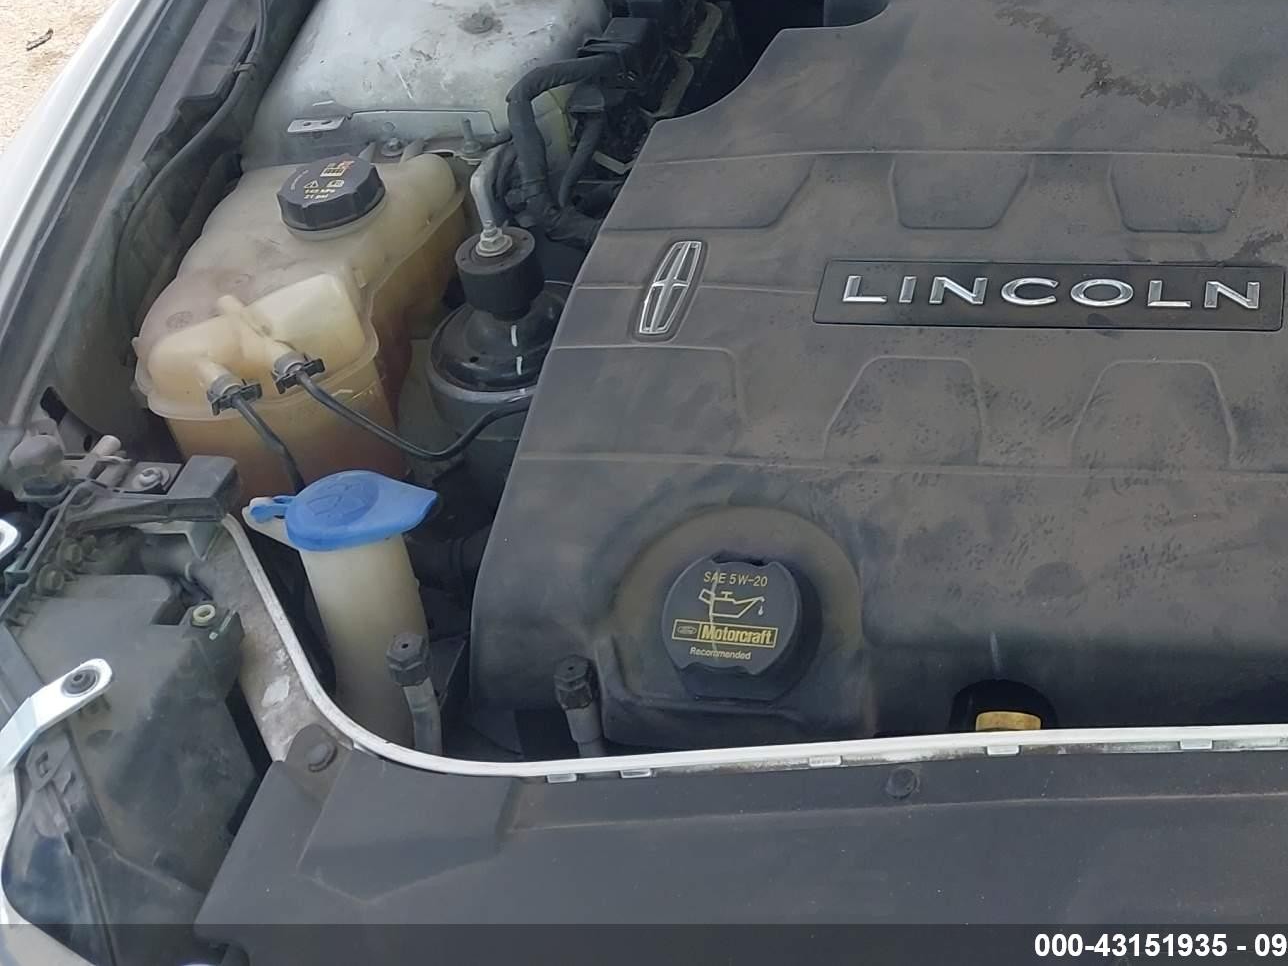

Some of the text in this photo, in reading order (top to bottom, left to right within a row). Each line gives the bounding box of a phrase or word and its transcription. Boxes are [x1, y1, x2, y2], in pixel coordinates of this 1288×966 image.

[841, 274, 1262, 310] LINCOLN
[703, 571, 727, 585] SAE
[701, 624, 772, 646] Motorcraft
[689, 646, 752, 661] Recommended
